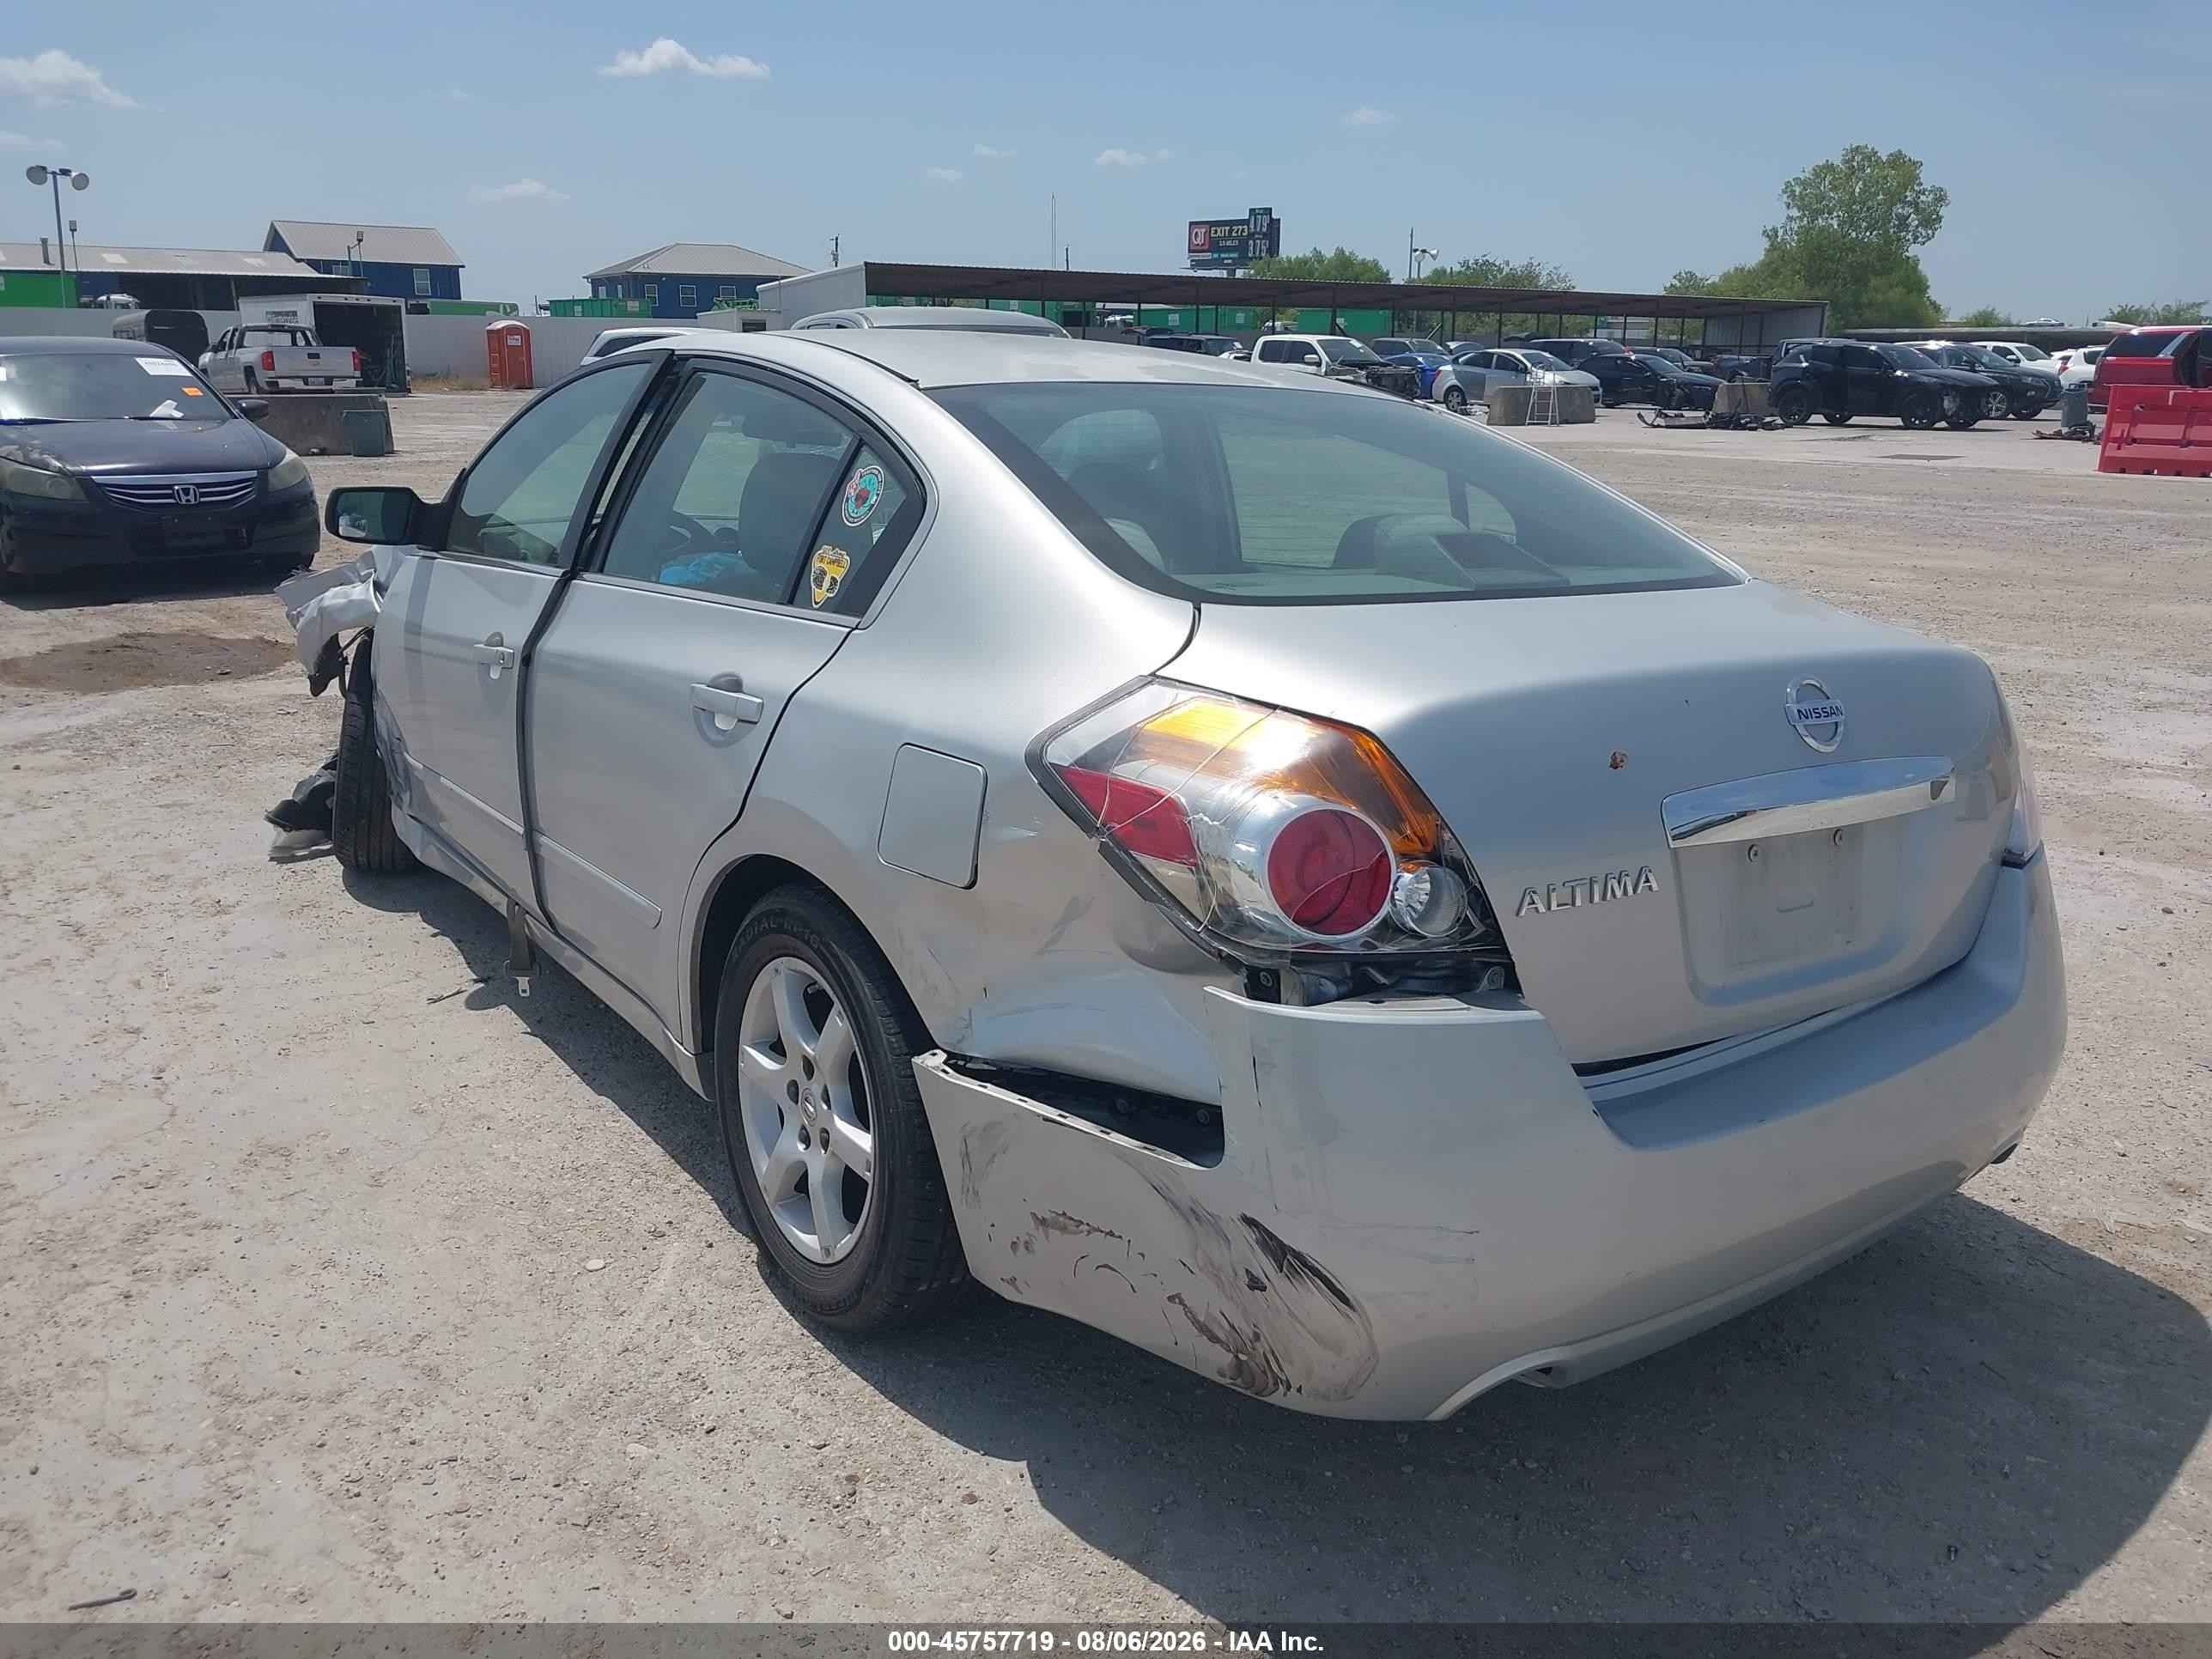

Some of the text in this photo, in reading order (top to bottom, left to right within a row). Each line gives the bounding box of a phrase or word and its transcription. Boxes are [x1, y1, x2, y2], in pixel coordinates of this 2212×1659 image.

[1192, 228, 1206, 246] QT
[1211, 225, 1249, 237] EXIT 273
[817, 555, 847, 568] FORT CAMPBELL
[1797, 704, 1844, 721] NISSAN
[1516, 866, 1660, 918] ALTIMA
[732, 915, 778, 963] RADIAL
